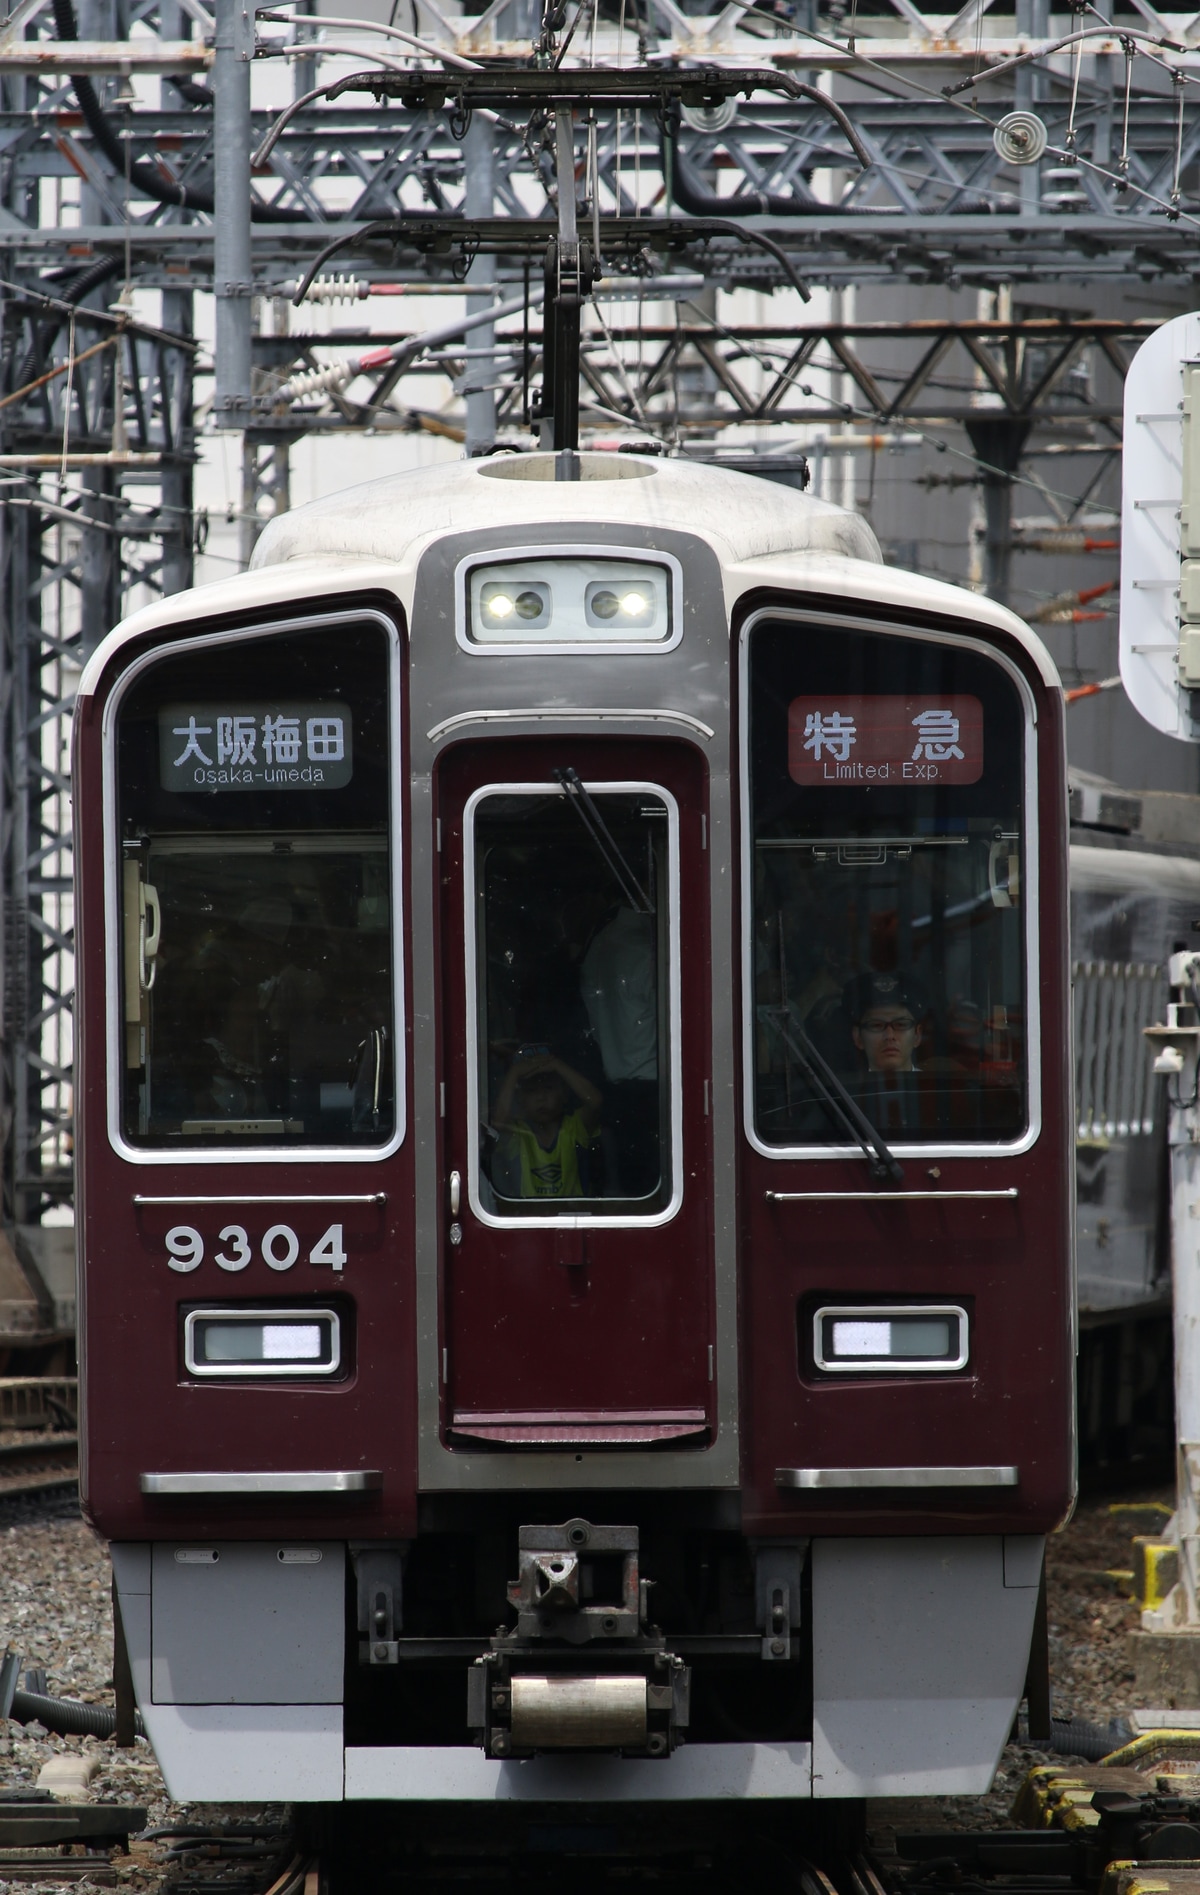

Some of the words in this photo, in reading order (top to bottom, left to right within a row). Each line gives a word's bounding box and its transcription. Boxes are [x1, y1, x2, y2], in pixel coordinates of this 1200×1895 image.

[172, 714, 345, 767] 大阪梅田
[194, 766, 325, 784] Osaka-umeda
[823, 762, 889, 779] Limited
[902, 762, 943, 780] Exp.
[165, 1224, 347, 1272] 9304
